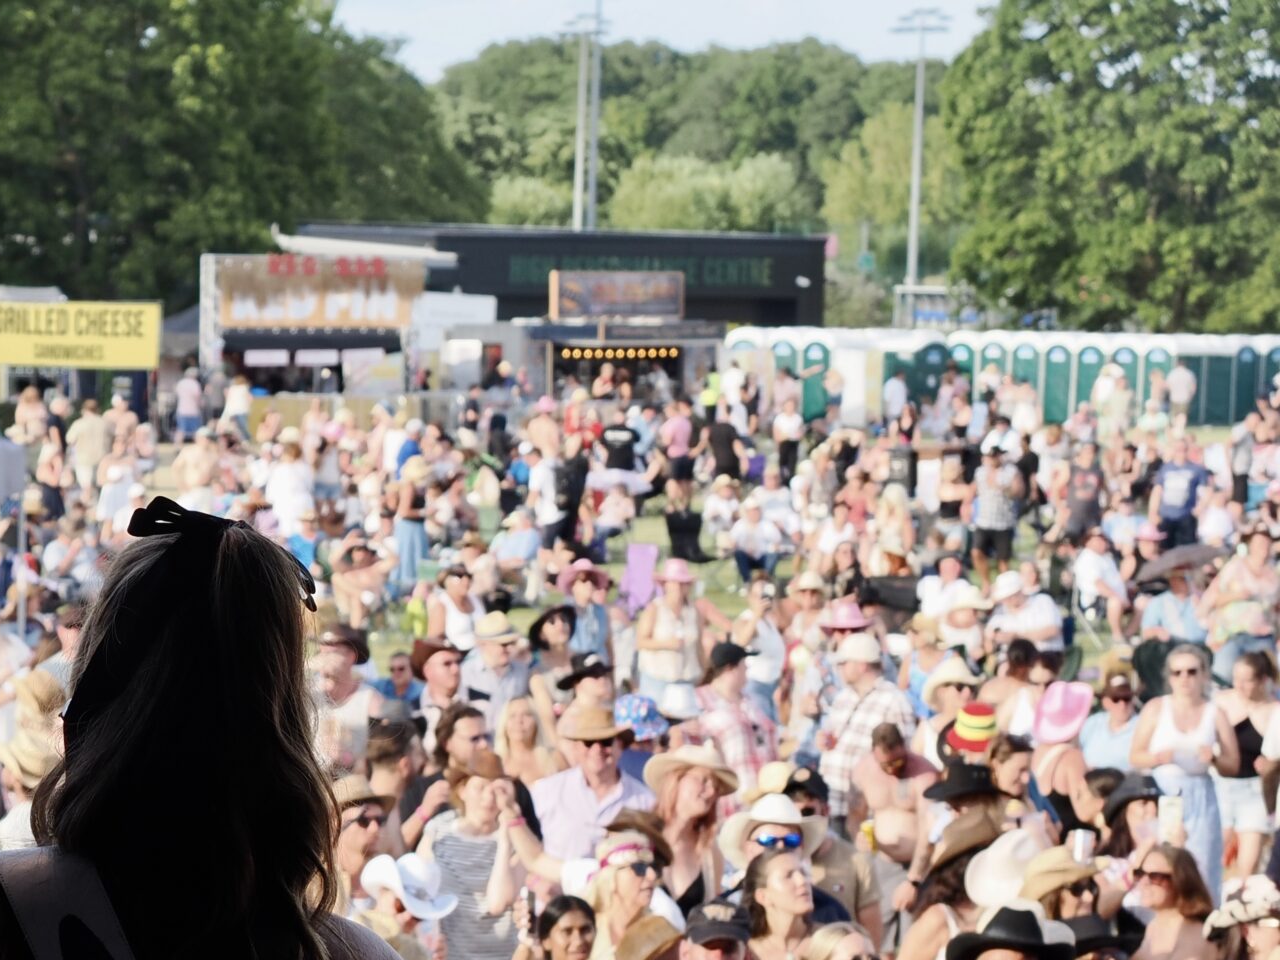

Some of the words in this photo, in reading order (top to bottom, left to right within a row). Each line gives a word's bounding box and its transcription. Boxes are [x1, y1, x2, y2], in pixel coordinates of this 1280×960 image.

[704, 257, 775, 287] CENTRE
[73, 308, 144, 337] CHEESE
[33, 343, 104, 360] SANDWICHES
